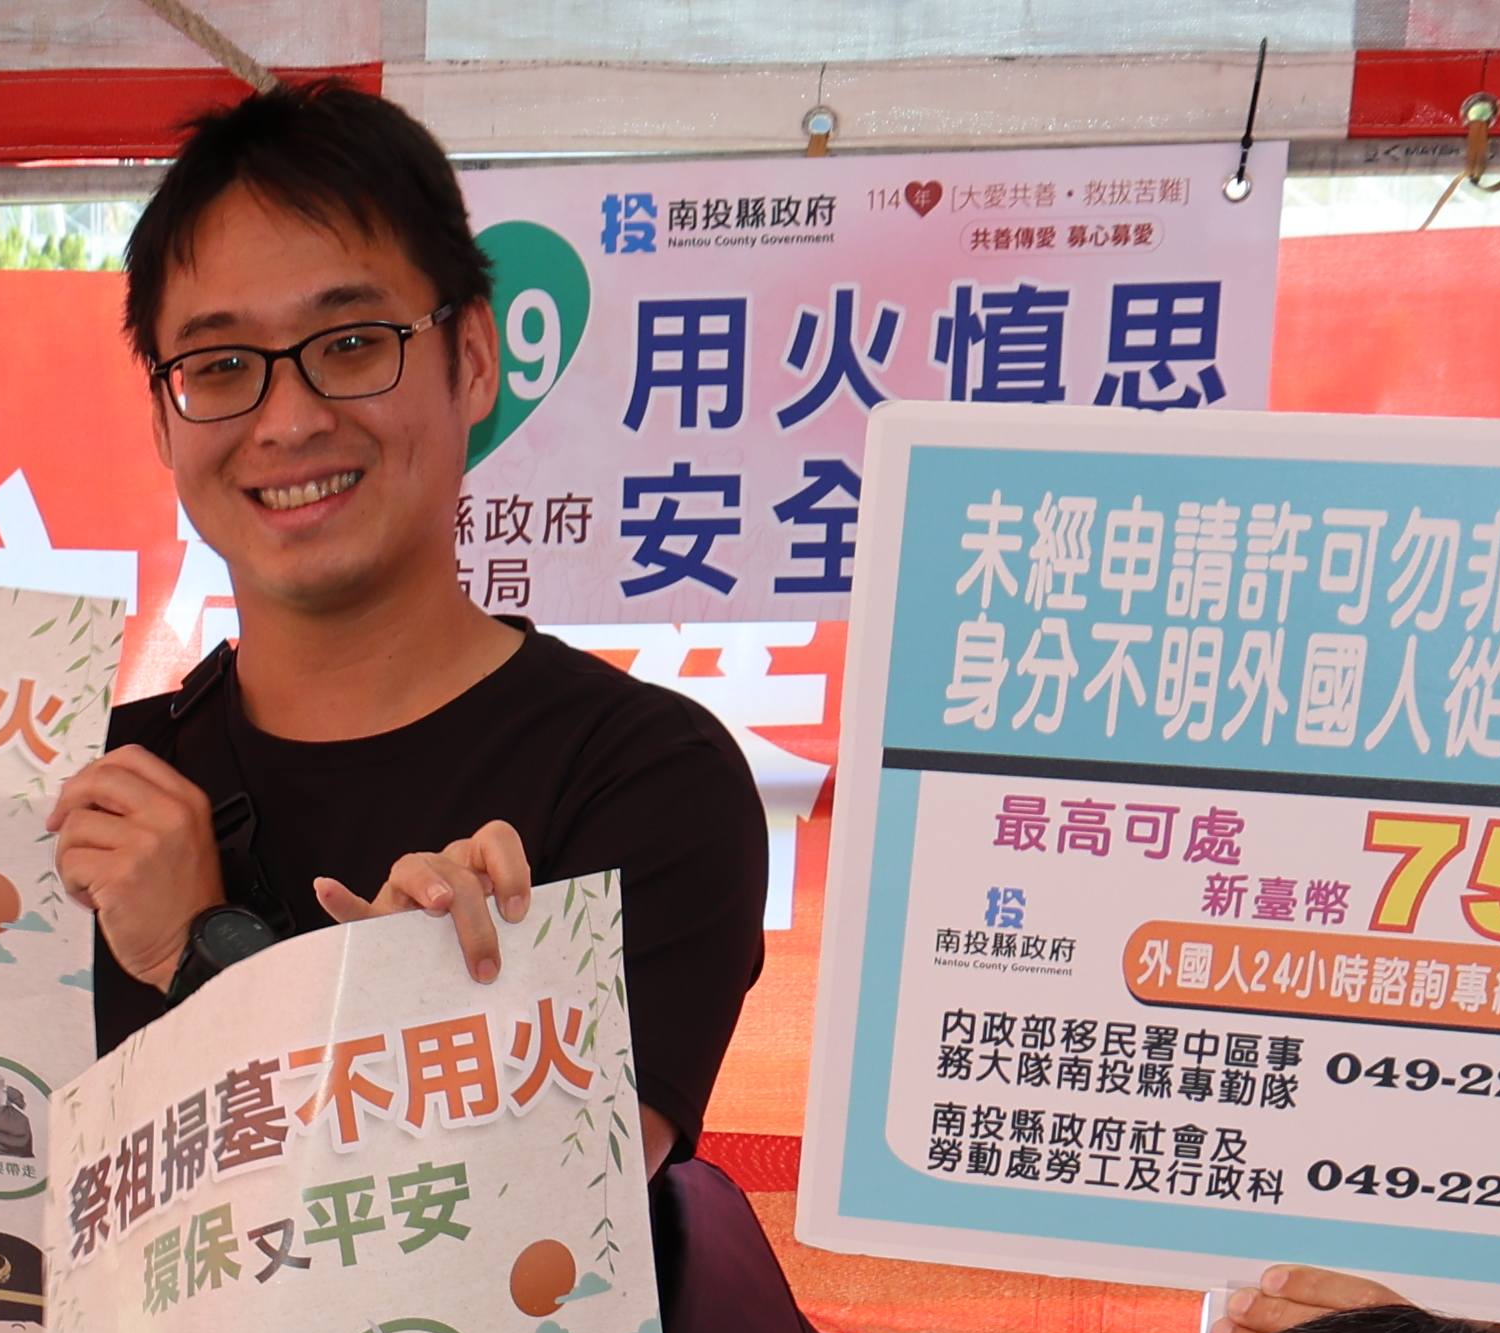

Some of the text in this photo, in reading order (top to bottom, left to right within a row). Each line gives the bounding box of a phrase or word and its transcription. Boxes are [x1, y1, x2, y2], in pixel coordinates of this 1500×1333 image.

[667, 193, 837, 231] 南投縣政府
[668, 232, 836, 249] Nantou County Government
[622, 280, 1229, 436] 用火慎思
[993, 794, 1247, 866] 最高可處
[1200, 872, 1351, 927] 新臺幣
[934, 926, 1078, 964] 南投縣政府
[934, 956, 1074, 978] Nantou County Government
[936, 1044, 1301, 1111] 務大隊南投縣專勤隊
[66, 995, 603, 1262] 祭祖掃墓不用火
[931, 1102, 1249, 1165] 南投縣政府社會及
[926, 1138, 1286, 1206] 勞動處勞工及行政科
[140, 1159, 474, 1316] 環保又平安
